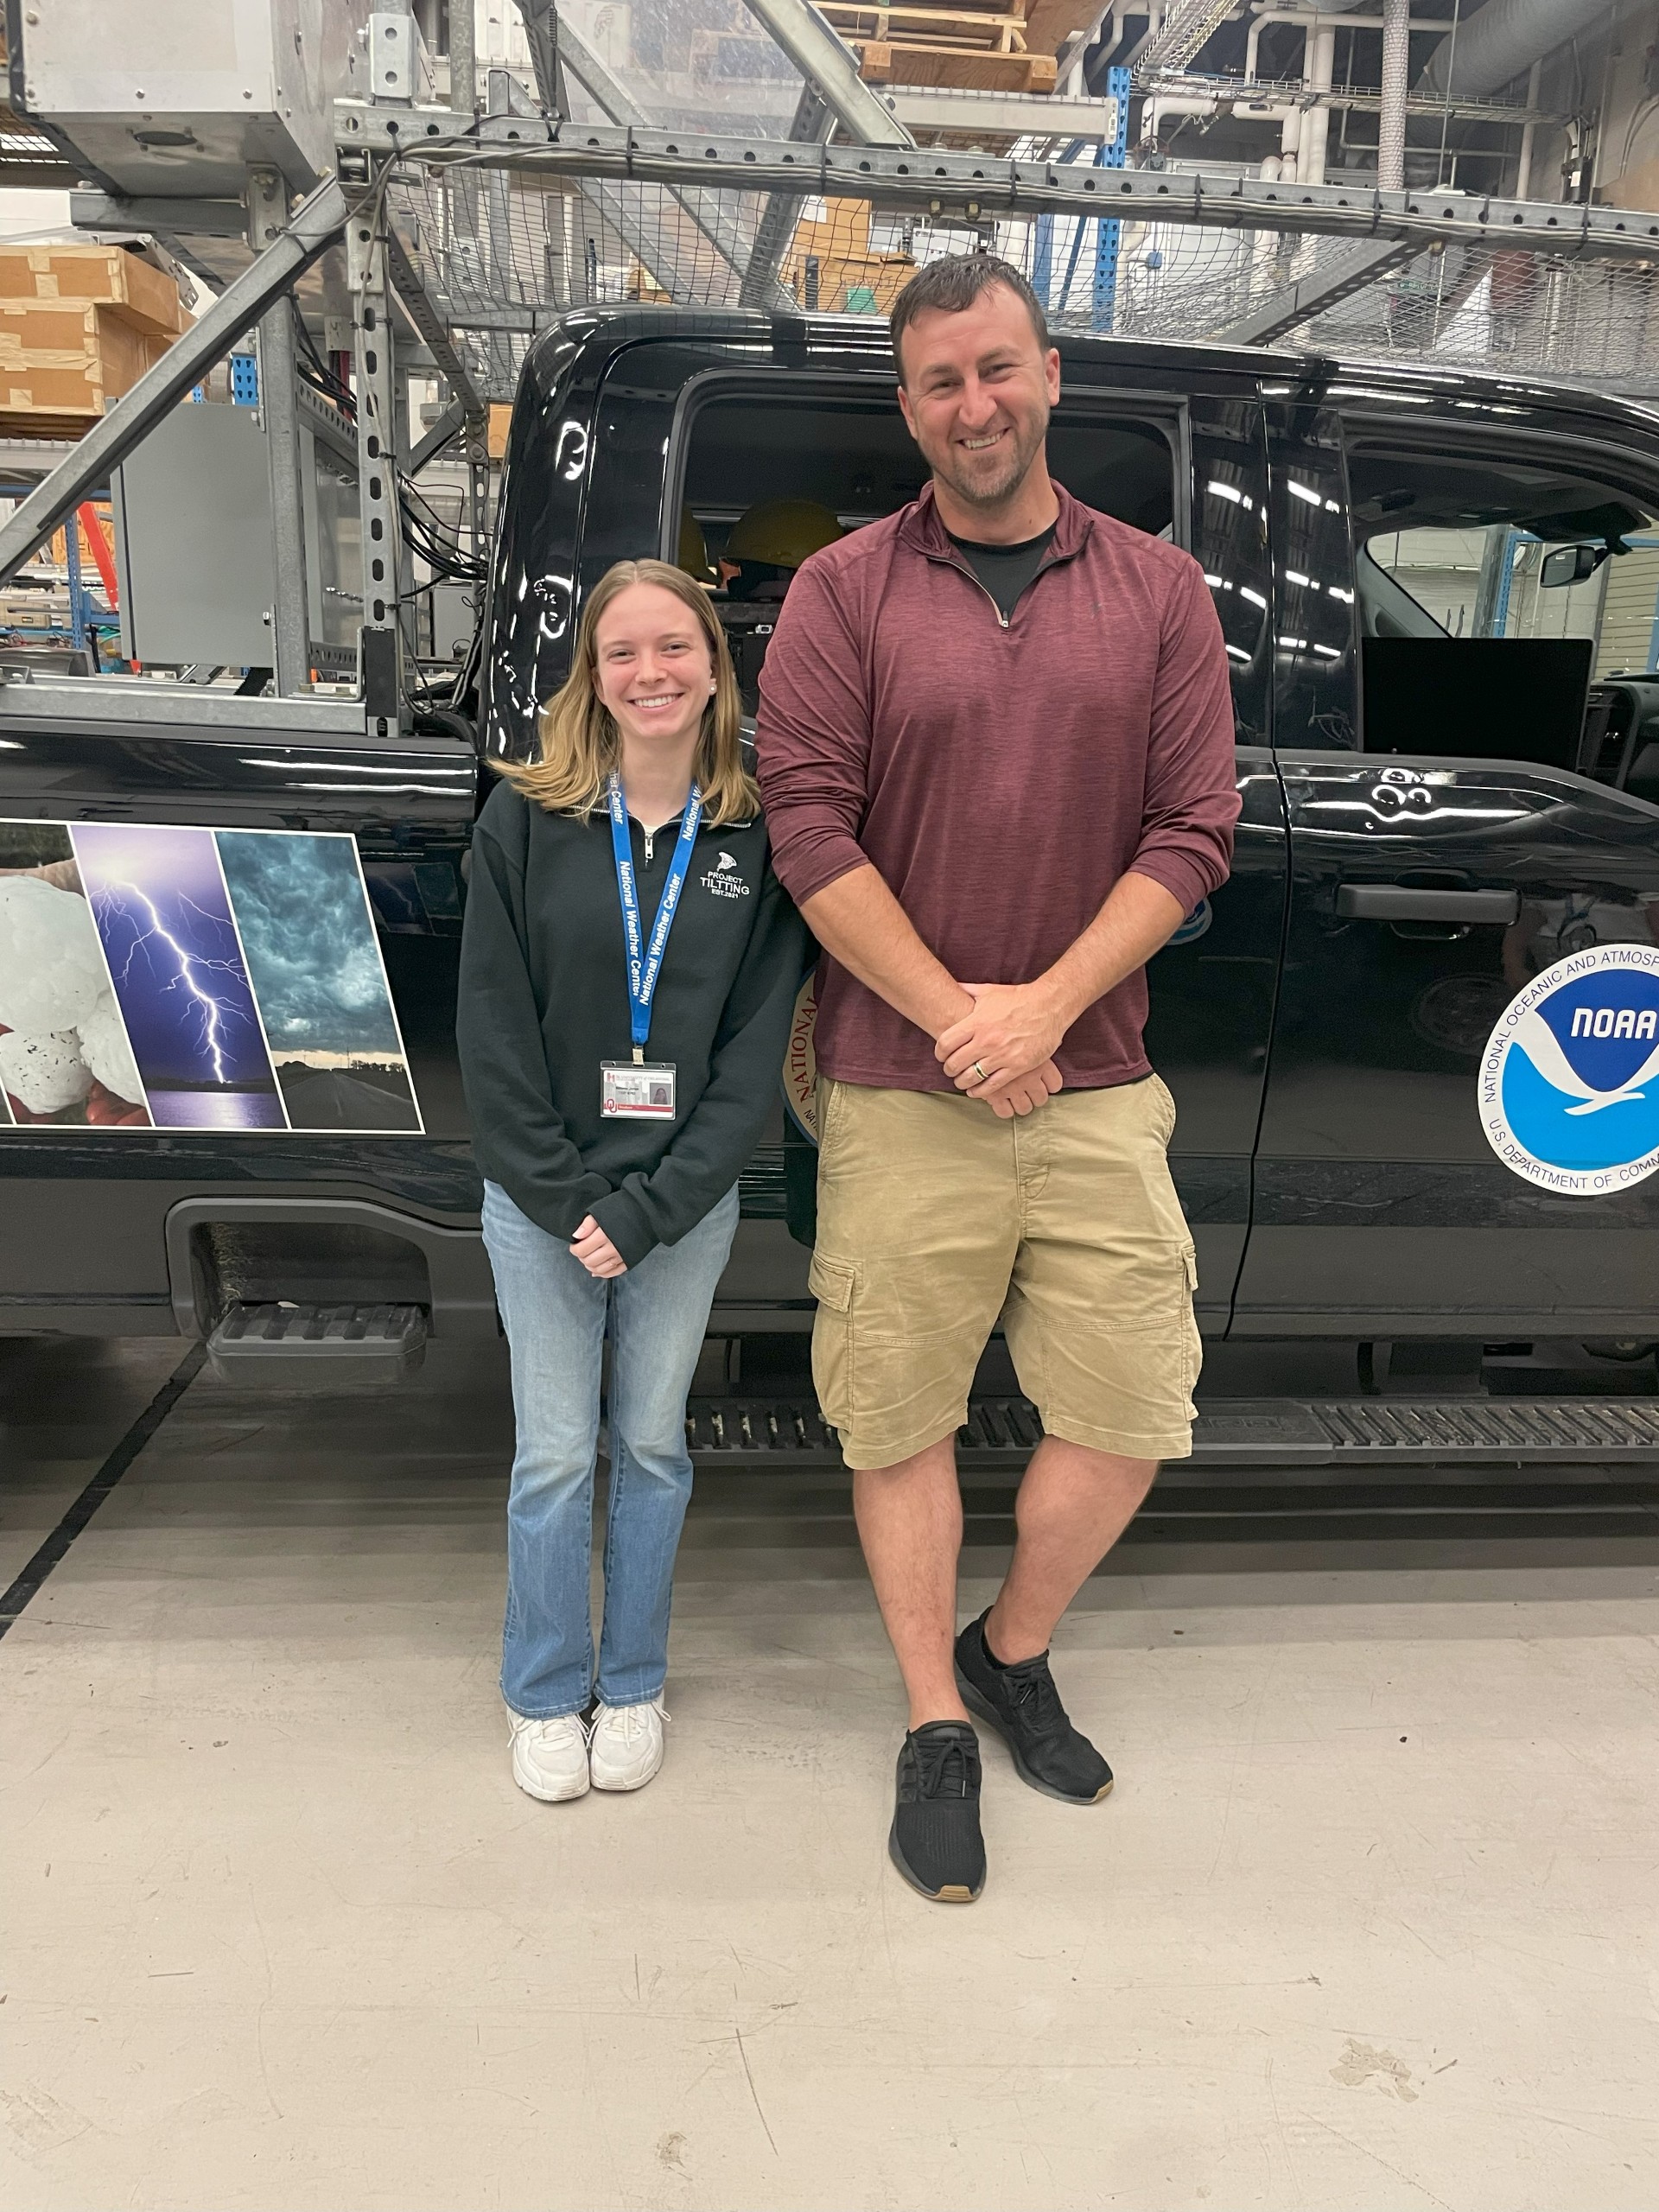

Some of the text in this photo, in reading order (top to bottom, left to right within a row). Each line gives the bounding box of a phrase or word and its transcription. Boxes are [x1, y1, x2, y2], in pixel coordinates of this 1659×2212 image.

[612, 791, 623, 825] Center
[682, 798, 700, 842] National
[620, 861, 635, 907] National
[700, 877, 750, 895] TILTTING
[707, 871, 743, 885] PROJECT
[626, 910, 639, 957] Weather
[639, 873, 682, 1006] National Weather Center
[1484, 1031, 1511, 1103] NATIONAL
[1506, 970, 1563, 1026] OCEANIC
[1566, 955, 1596, 976] AND
[1571, 1007, 1657, 1039] NOAA
[1489, 1118, 1506, 1146] U.S.
[1503, 1144, 1588, 1189] DEPARTMENT
[1593, 1174, 1612, 1188] OF
